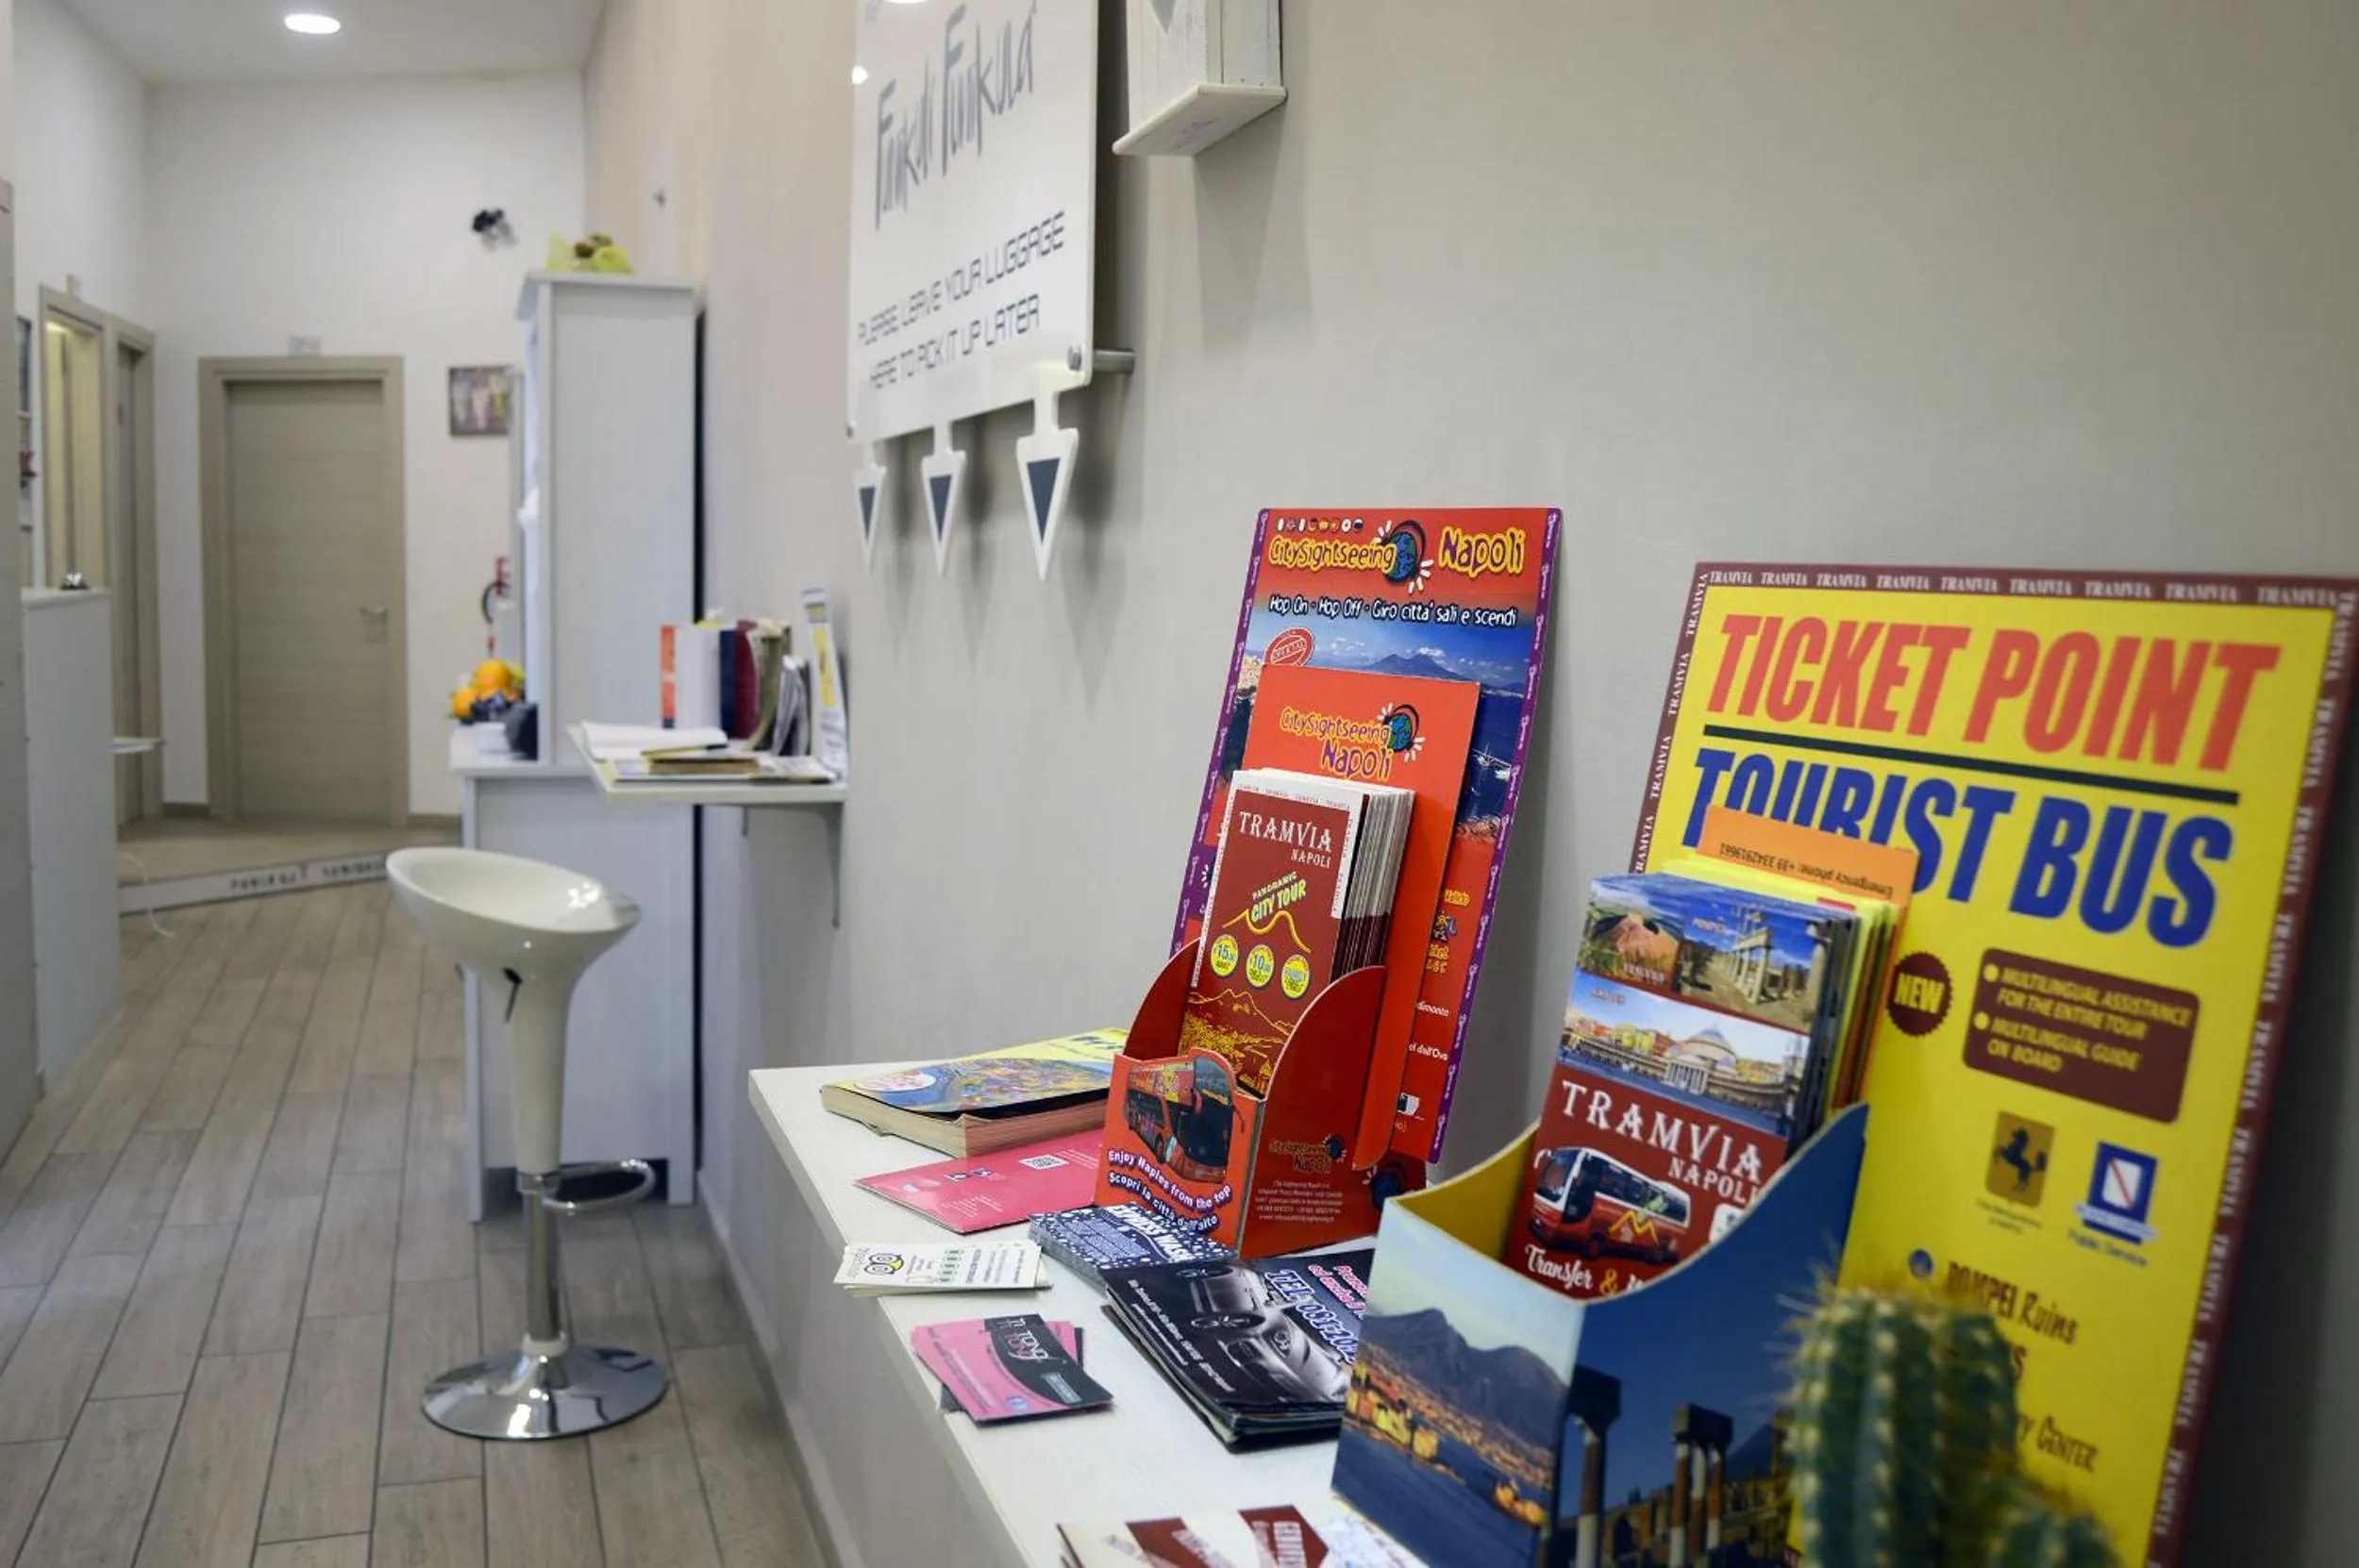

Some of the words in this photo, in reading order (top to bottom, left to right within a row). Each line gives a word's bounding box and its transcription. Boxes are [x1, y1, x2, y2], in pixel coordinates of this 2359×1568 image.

[902, 280, 942, 326] LEAVE
[945, 257, 982, 304] YOUR
[985, 210, 1065, 285] LUGGAGE
[962, 319, 981, 358] UP
[985, 292, 1040, 347] LATER
[1438, 525, 1526, 579] Napoli
[1710, 570, 1753, 585] TRAMVIA
[1761, 572, 1808, 586] TRAMVIA
[1815, 573, 1867, 588] TRAMVIA
[1876, 574, 1930, 590] TRAMVIA
[1940, 576, 1998, 593] TRAMVIA
[2009, 578, 2072, 596] TRAMVIA
[2084, 580, 2152, 599] TRAMVIA
[1269, 595, 1291, 613] Hop
[1292, 597, 1308, 613] On
[1318, 599, 1340, 619] Hop
[1344, 598, 1363, 618] Off
[1372, 599, 1397, 620] Giro
[1436, 605, 1458, 624] sali
[1461, 611, 1470, 624] e
[1474, 609, 1517, 626] scendi
[1706, 613, 1971, 739] TICKET
[1963, 626, 2283, 773] POINT
[1635, 815, 1655, 876] RAMVIA
[1650, 735, 1672, 801] TRAMVIA
[1667, 652, 1690, 717] TRAMVIA
[1684, 572, 1709, 638] TRAMVIA
[1321, 738, 1394, 782] Napoli
[1238, 810, 1332, 854] TRAMVIA
[1291, 849, 1332, 869] NAPOLI
[2008, 795, 2235, 948] BUS
[1251, 893, 1276, 923] CITY
[1277, 877, 1307, 909] TOUR
[1252, 870, 1297, 901] PANORAMIC
[1893, 973, 1945, 1015] NEW
[1996, 988, 2025, 1010] FOR
[2025, 996, 2054, 1020] THE
[2053, 1003, 2103, 1029] ENTIRE
[2103, 1015, 2149, 1041] TOUR
[2002, 967, 2100, 1010] MULTILINGUAL
[2100, 991, 2194, 1028] ASSISTANCE
[1986, 1039, 2012, 1059] ON
[2011, 1045, 2064, 1075] BOARD
[2090, 1041, 2143, 1073] GUIDE
[1562, 1079, 1764, 1185] TRAMVIA
[1108, 1150, 1135, 1165] Enjoy
[1137, 1156, 1171, 1190] Naples
[1170, 1184, 1194, 1208] from
[1196, 1197, 1213, 1209] the
[1213, 1185, 1231, 1203] top
[1109, 1172, 1141, 1192] Scopri
[1141, 1186, 1151, 1201] la
[1151, 1199, 1176, 1221] città
[1667, 1155, 1762, 1205] NAPOLI
[1524, 1243, 1594, 1291] Transfer
[1598, 1268, 1618, 1295] &
[2021, 1291, 2079, 1345] Ruins
